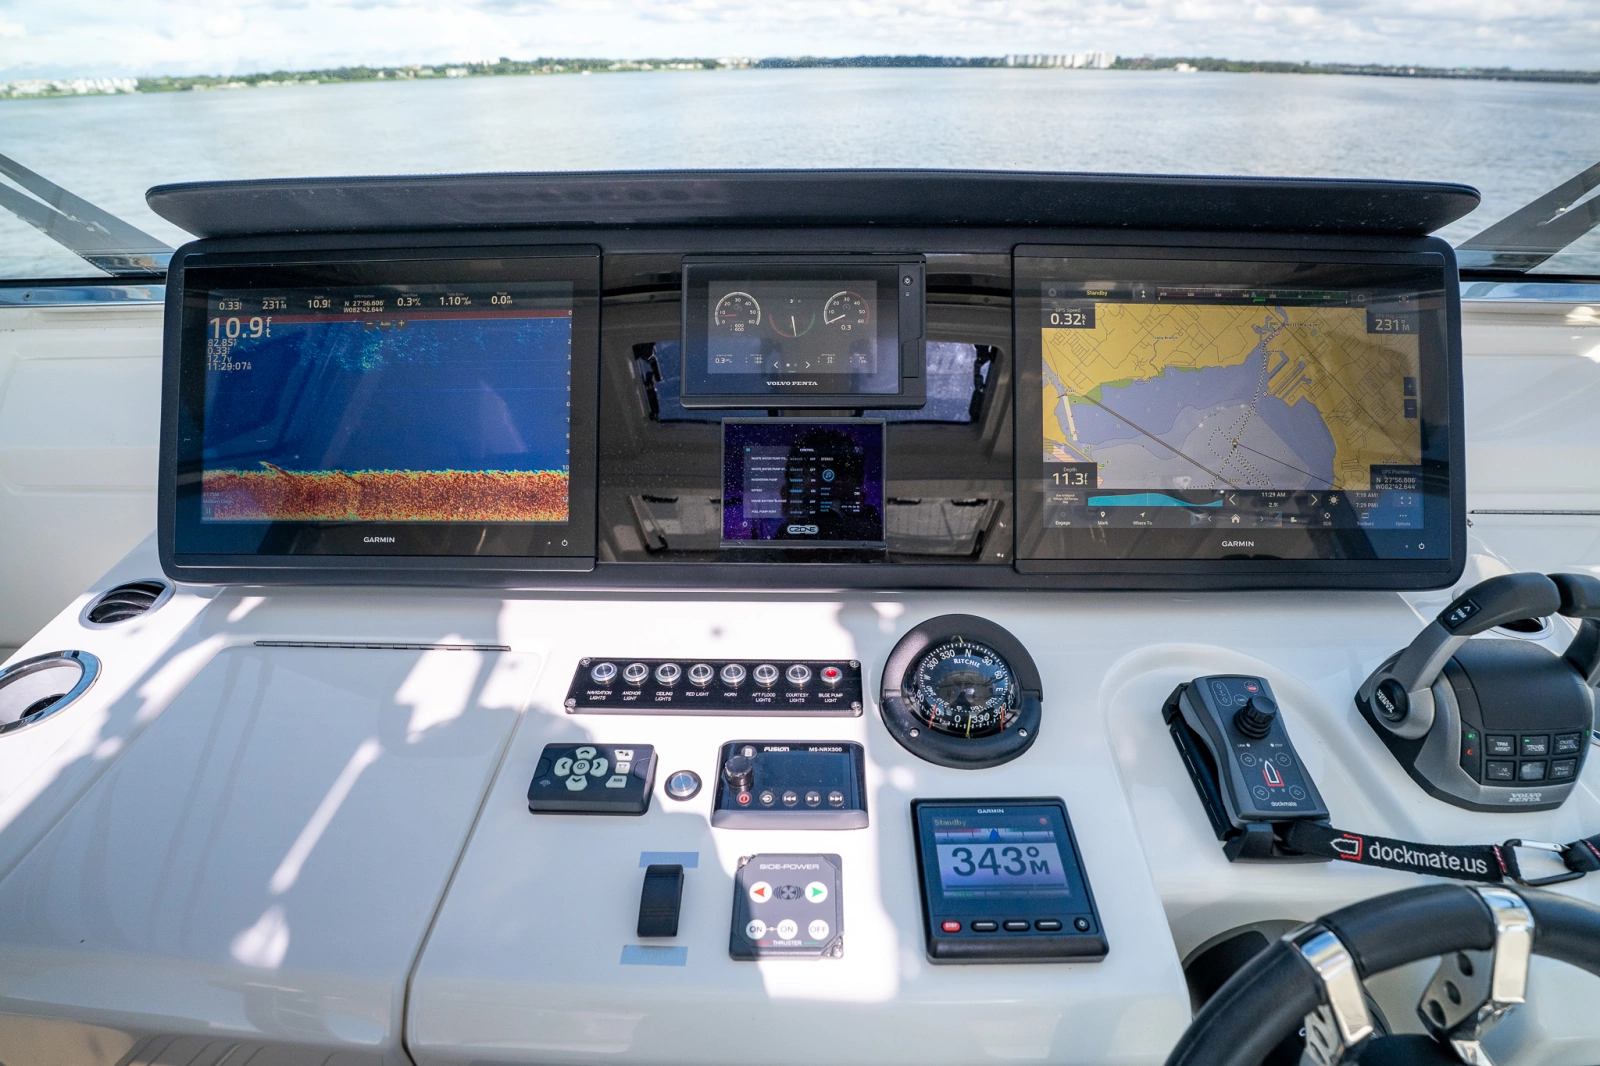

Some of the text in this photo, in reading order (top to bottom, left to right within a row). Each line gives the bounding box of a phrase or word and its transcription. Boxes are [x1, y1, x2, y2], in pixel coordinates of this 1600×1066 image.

[940, 650, 955, 660] 330
[965, 649, 972, 658] N
[927, 658, 939, 670] 300
[953, 658, 980, 668] RITCHIE
[982, 656, 993, 666] 30
[972, 713, 990, 723] 330
[1369, 842, 1488, 874] dockmate.us
